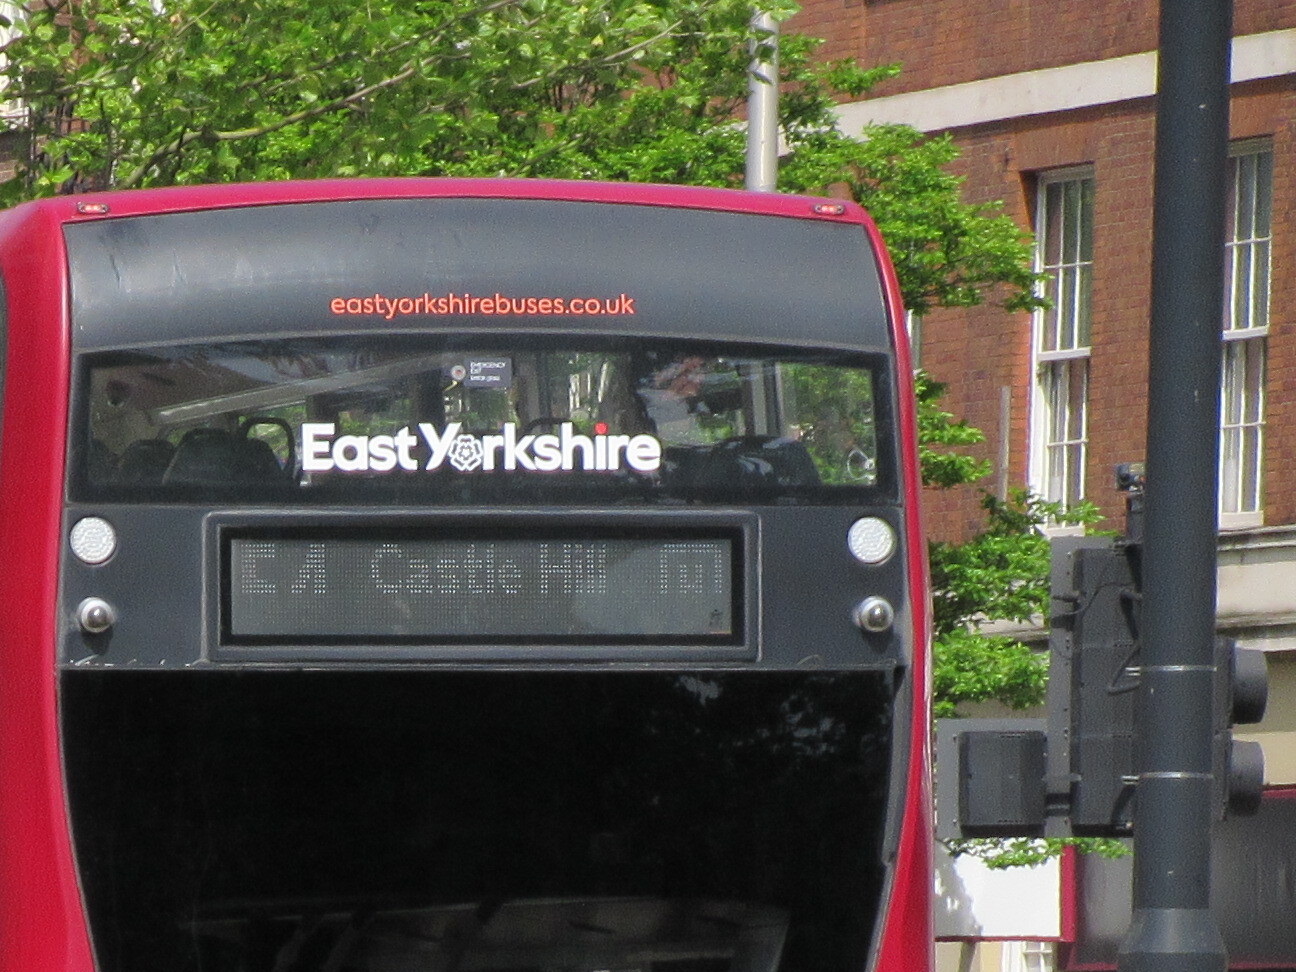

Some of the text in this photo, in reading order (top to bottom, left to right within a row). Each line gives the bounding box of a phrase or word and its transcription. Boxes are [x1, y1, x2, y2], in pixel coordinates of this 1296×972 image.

[330, 293, 635, 319] eastyorkshirebuses.co.uk
[301, 422, 418, 471] East
[371, 542, 521, 594] Castle
[540, 542, 606, 594] Hill
